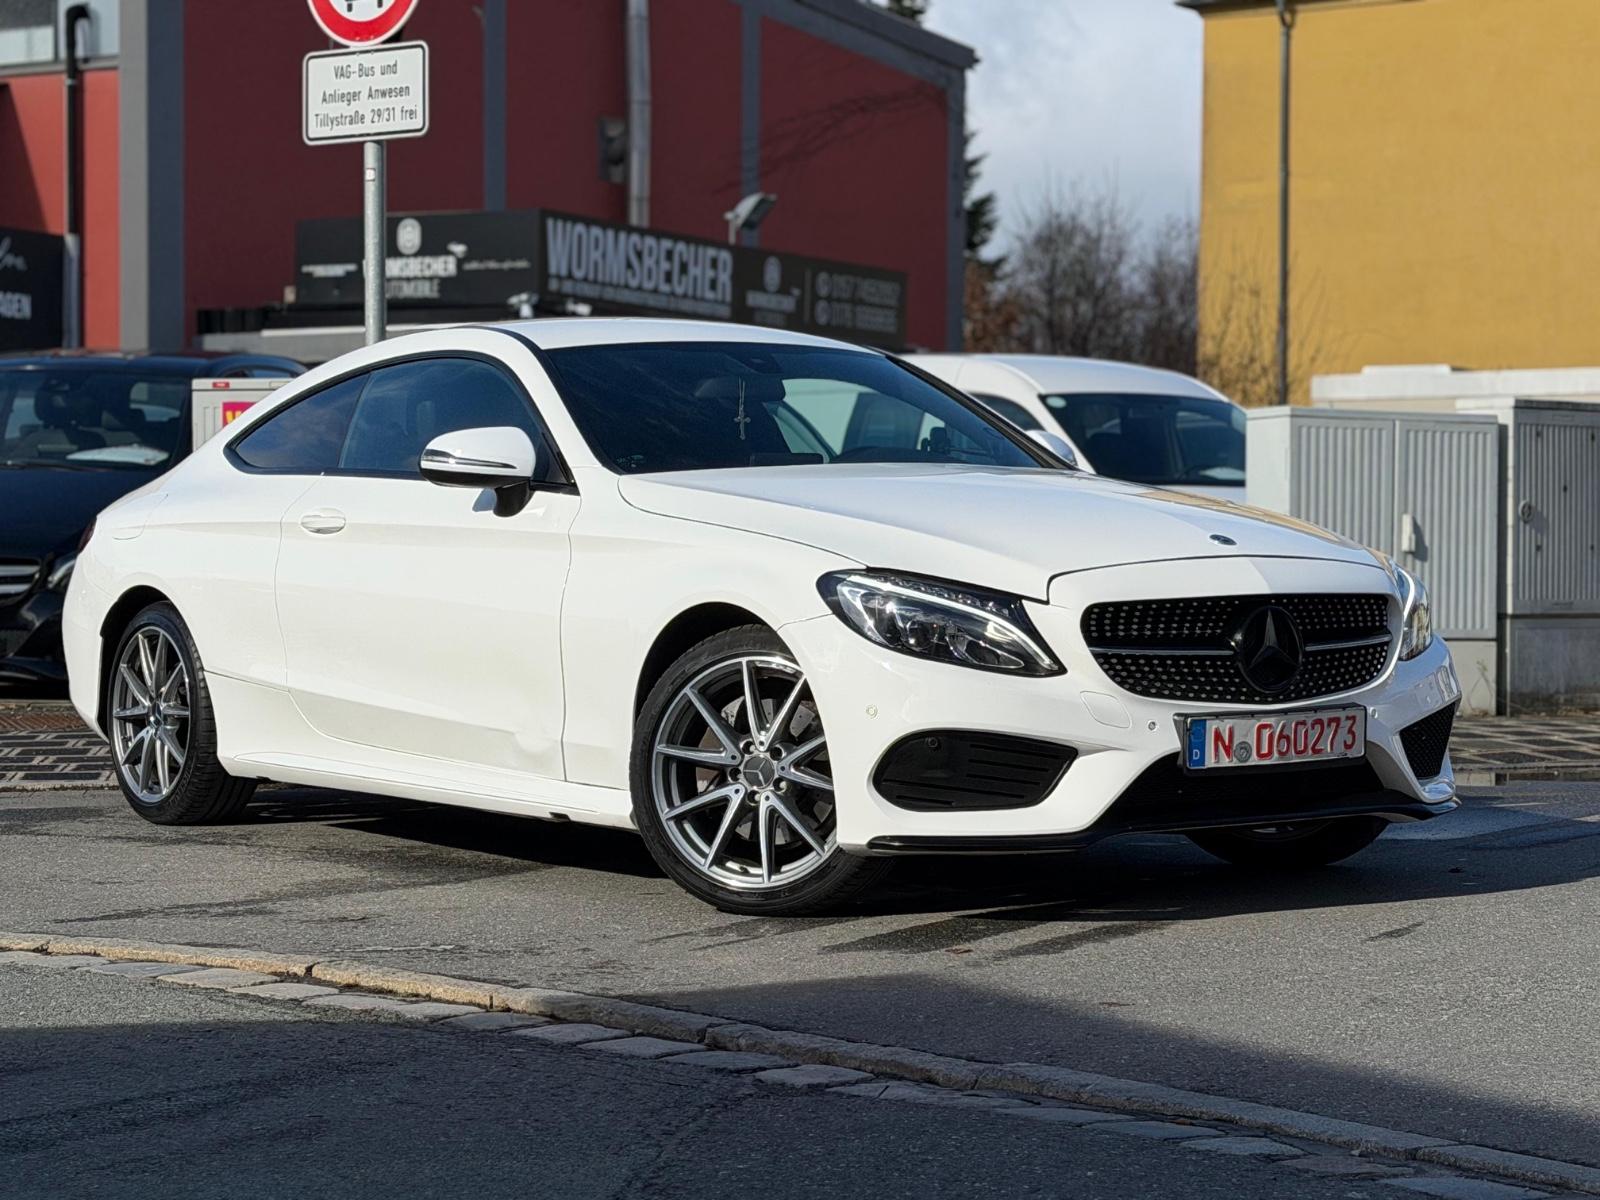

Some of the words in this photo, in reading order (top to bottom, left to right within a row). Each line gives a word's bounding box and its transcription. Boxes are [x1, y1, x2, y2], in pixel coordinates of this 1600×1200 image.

[334, 63, 375, 80] VAG-Bus
[380, 59, 398, 76] und
[321, 88, 362, 106] Anlieger
[367, 85, 410, 101] Anwesen
[314, 110, 365, 131] Tillystraße
[370, 106, 396, 124] 29/31
[400, 104, 417, 121] frei
[547, 217, 734, 303] WORMSBECHER
[1212, 724, 1233, 763] N
[1254, 714, 1357, 760] 060273
[1192, 749, 1200, 760] D
